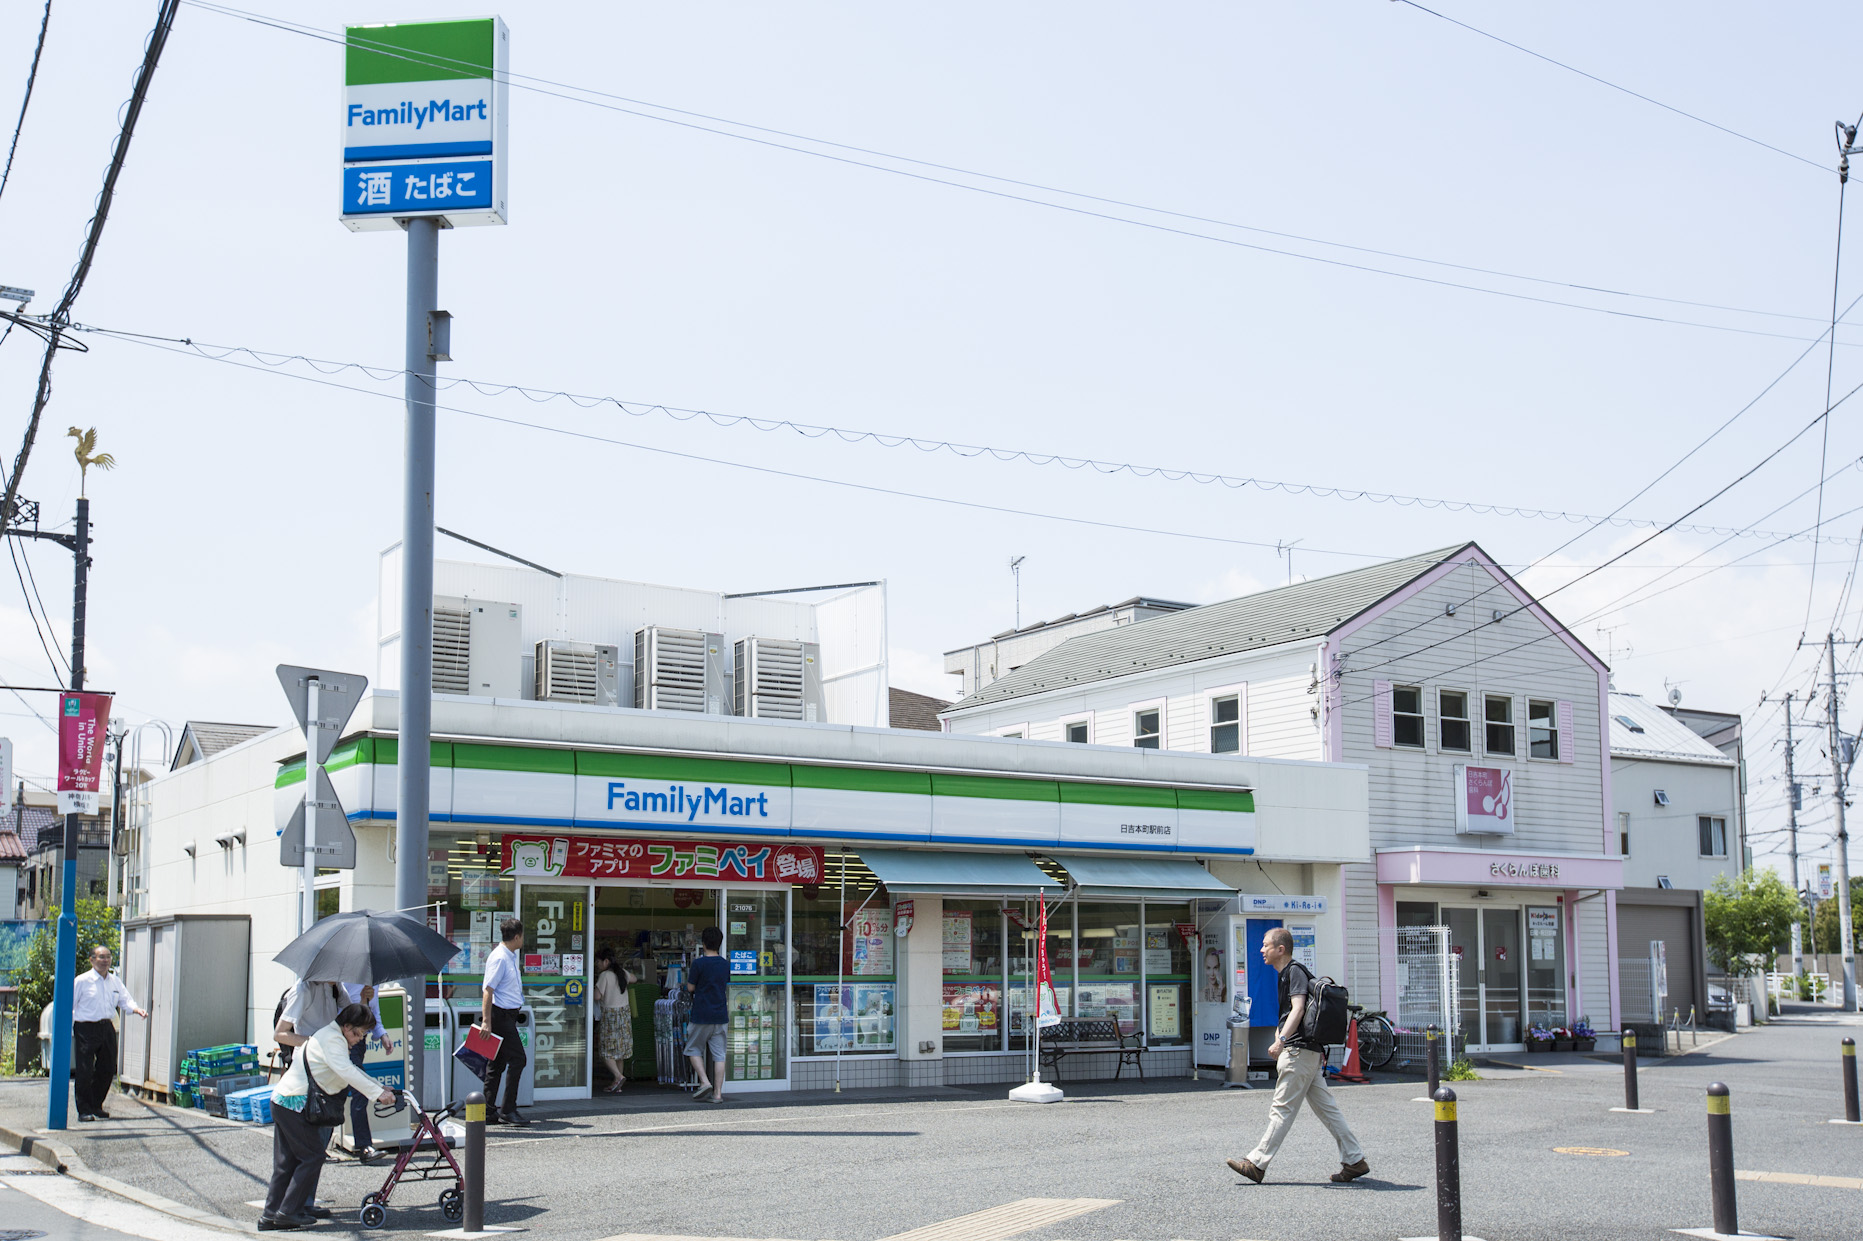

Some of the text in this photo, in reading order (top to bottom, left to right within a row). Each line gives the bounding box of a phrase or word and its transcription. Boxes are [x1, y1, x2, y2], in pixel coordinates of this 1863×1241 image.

[348, 99, 487, 130] FamilyMart
[357, 171, 477, 205] 酒 たばこ
[87, 718, 96, 735] The
[77, 721, 87, 760] in Union
[1468, 770, 1488, 779] 日吉本町
[1468, 779, 1493, 787] さくらんぼ
[1468, 786, 1478, 794] 歯科
[607, 782, 768, 821] FamilyMart
[1120, 824, 1171, 835] 日吉本町駅前店
[576, 841, 643, 859] ファミマの
[589, 859, 630, 875] アプリ
[647, 844, 770, 878] ファミペイ
[776, 853, 817, 879] 登場
[1490, 862, 1560, 879] さくらんぼ歯科
[954, 986, 986, 996] ファミペイ
[1203, 1033, 1220, 1041] DNP
